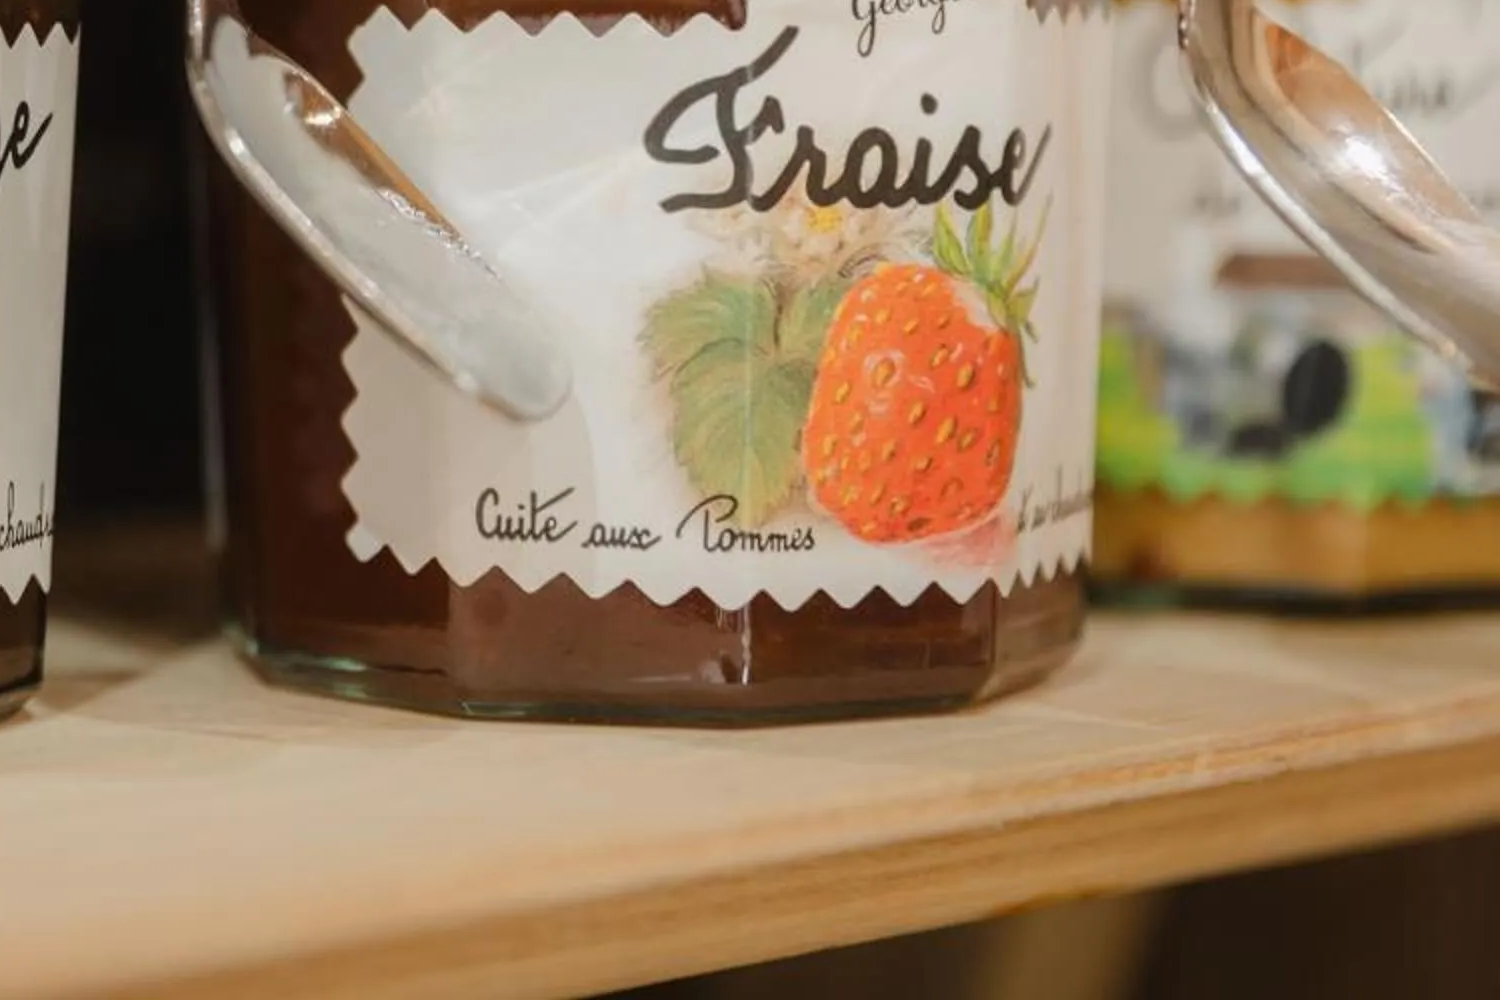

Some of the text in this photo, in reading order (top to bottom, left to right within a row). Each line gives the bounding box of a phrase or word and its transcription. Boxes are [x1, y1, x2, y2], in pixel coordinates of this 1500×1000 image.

[643, 25, 1052, 213] Fraise
[475, 487, 816, 553] Cuite aux Pommes
